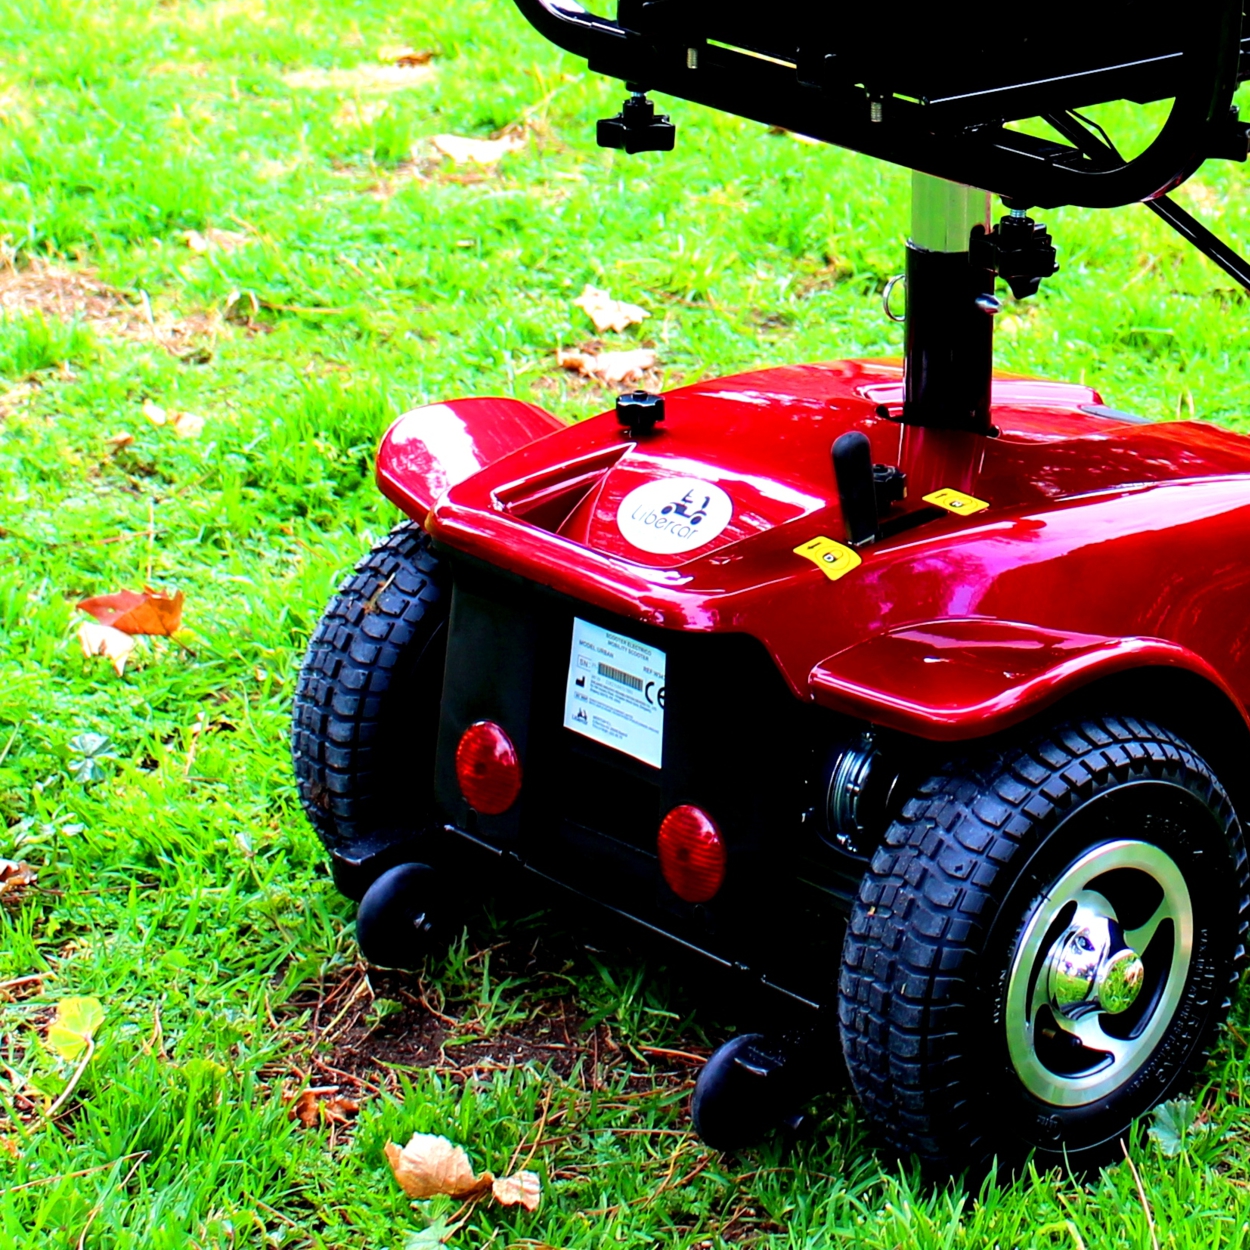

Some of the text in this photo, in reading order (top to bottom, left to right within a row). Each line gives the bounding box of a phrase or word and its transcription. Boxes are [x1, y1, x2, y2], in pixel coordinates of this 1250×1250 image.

[631, 504, 698, 540] Libercar
[579, 639, 614, 658] MODEL URBAN
[606, 632, 627, 646] SCOOTER
[607, 640, 649, 661] MOBILITY SCOOTER
